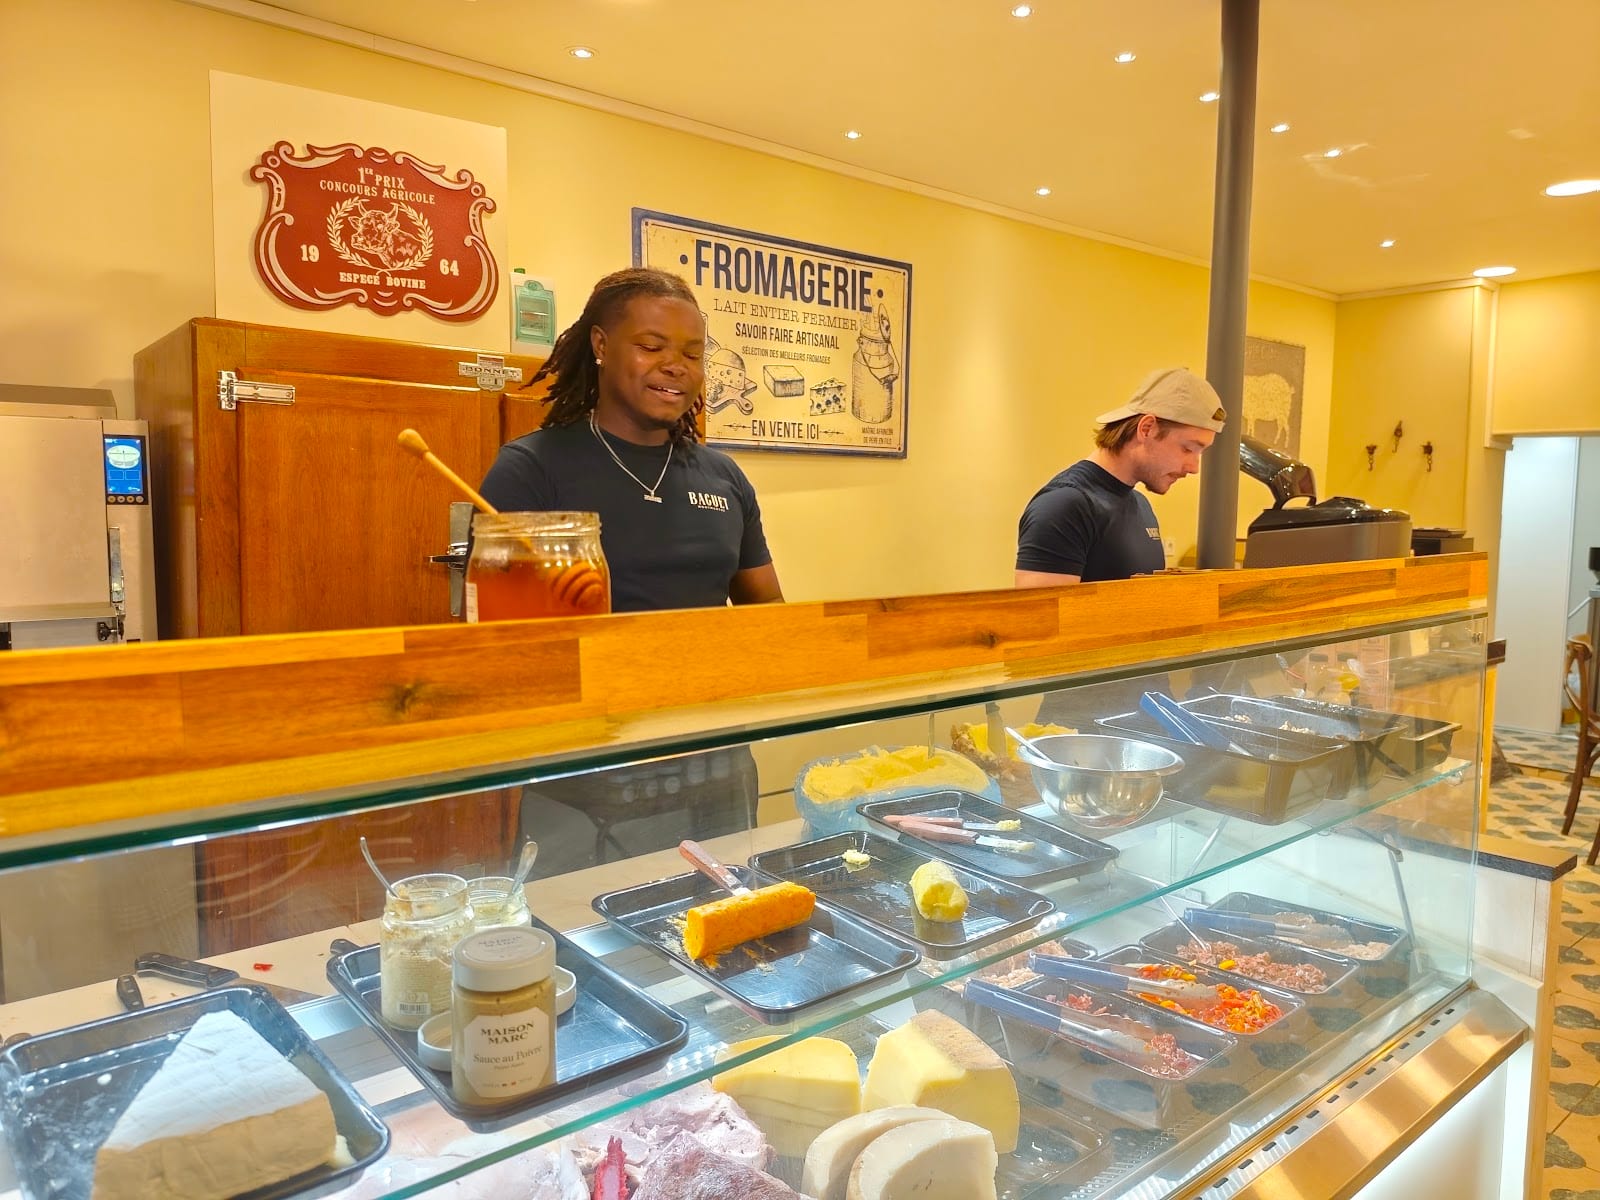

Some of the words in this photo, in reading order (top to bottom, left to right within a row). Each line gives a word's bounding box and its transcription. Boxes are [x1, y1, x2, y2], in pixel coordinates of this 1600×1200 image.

[375, 175, 405, 189] PRIX
[319, 179, 378, 196] CONCOURS
[382, 188, 436, 205] AGRICOLE
[300, 244, 320, 263] 19
[439, 259, 460, 277] 64
[695, 239, 873, 313] FROMAGERIE
[386, 276, 427, 290] BOVINE
[713, 298, 747, 315] LAIT
[750, 304, 800, 323] ENTIER
[802, 311, 859, 331] FERMIER
[735, 322, 767, 340] SAVOIR
[769, 327, 794, 344] FAIRE
[795, 331, 840, 350] ARTISANAL
[769, 349, 779, 358] DES
[751, 419, 766, 437] EN
[769, 420, 803, 439] VENTE
[806, 423, 820, 440] ICI
[687, 491, 729, 510] BAGUET
[480, 1021, 534, 1037] MAISON
[487, 1031, 529, 1045] MARC
[473, 1054, 501, 1065] Sauce
[502, 1055, 514, 1063] au
